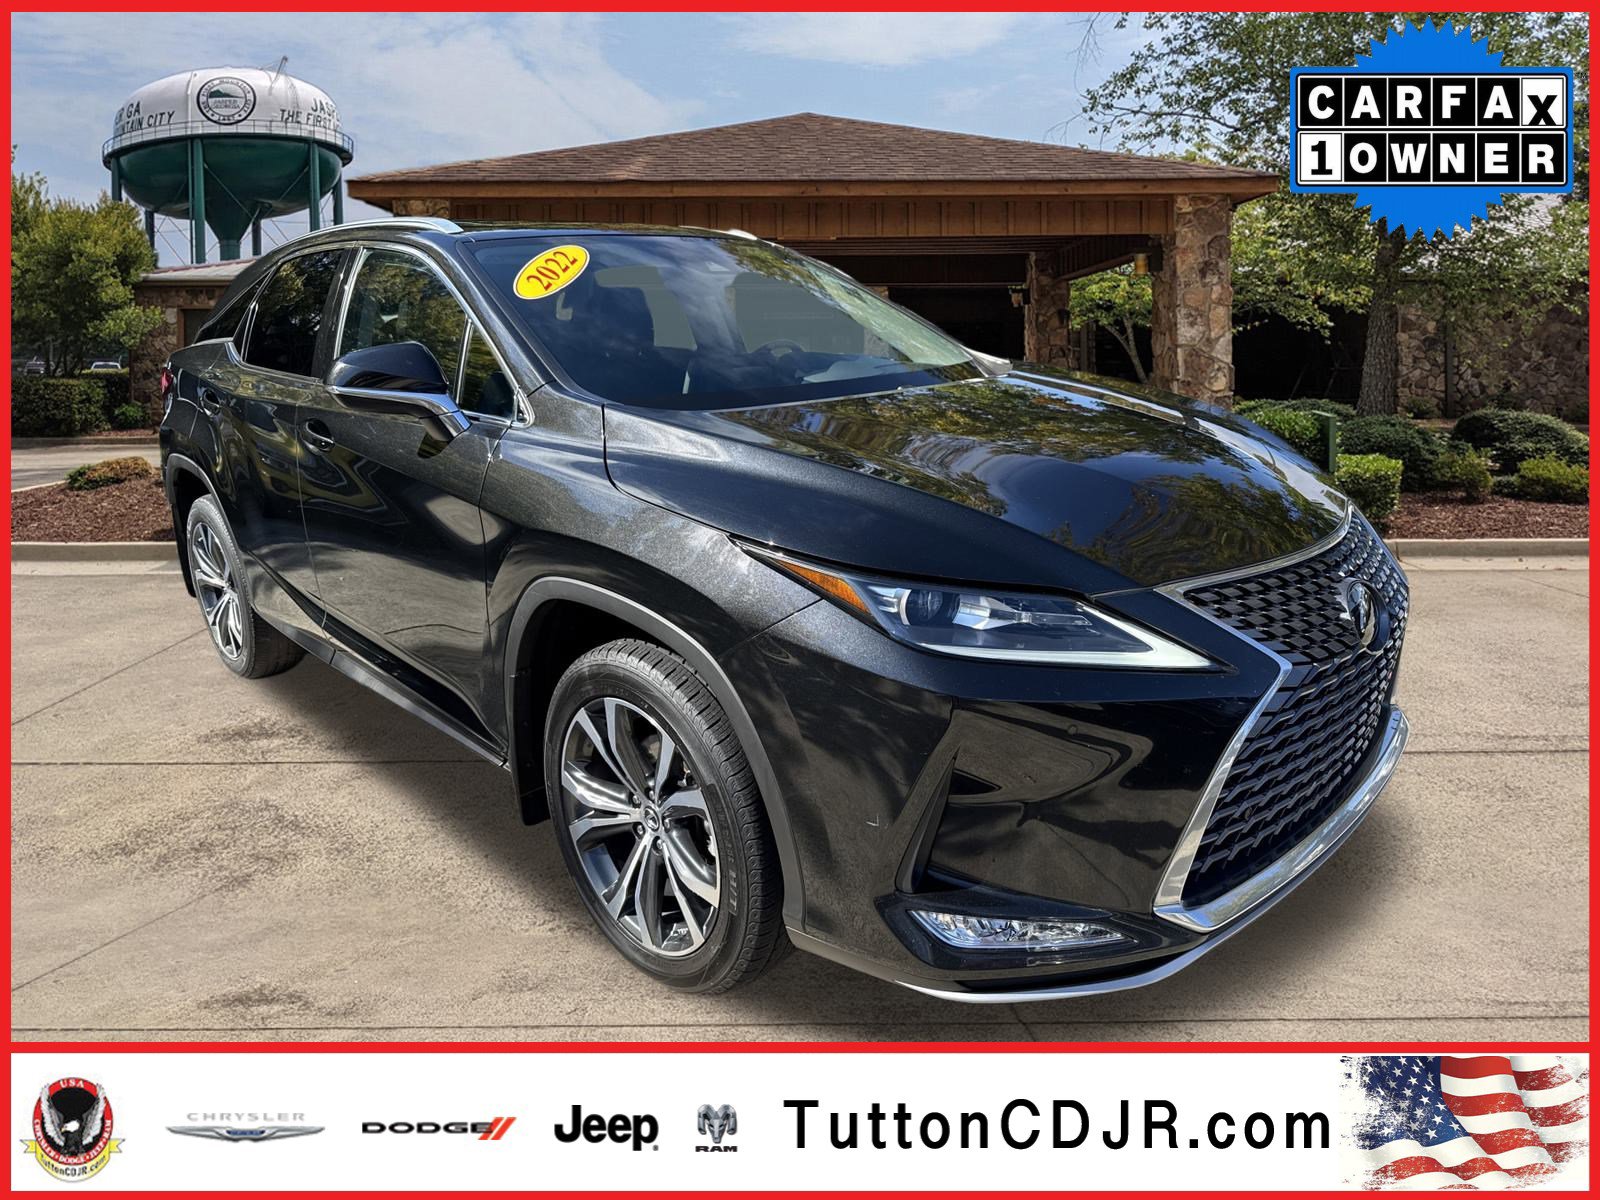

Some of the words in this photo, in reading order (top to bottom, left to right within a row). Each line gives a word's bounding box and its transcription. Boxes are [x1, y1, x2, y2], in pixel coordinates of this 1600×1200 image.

[126, 100, 140, 119] GA
[147, 110, 175, 127] CITY
[280, 109, 302, 124] THE
[526, 251, 578, 291] 2022
